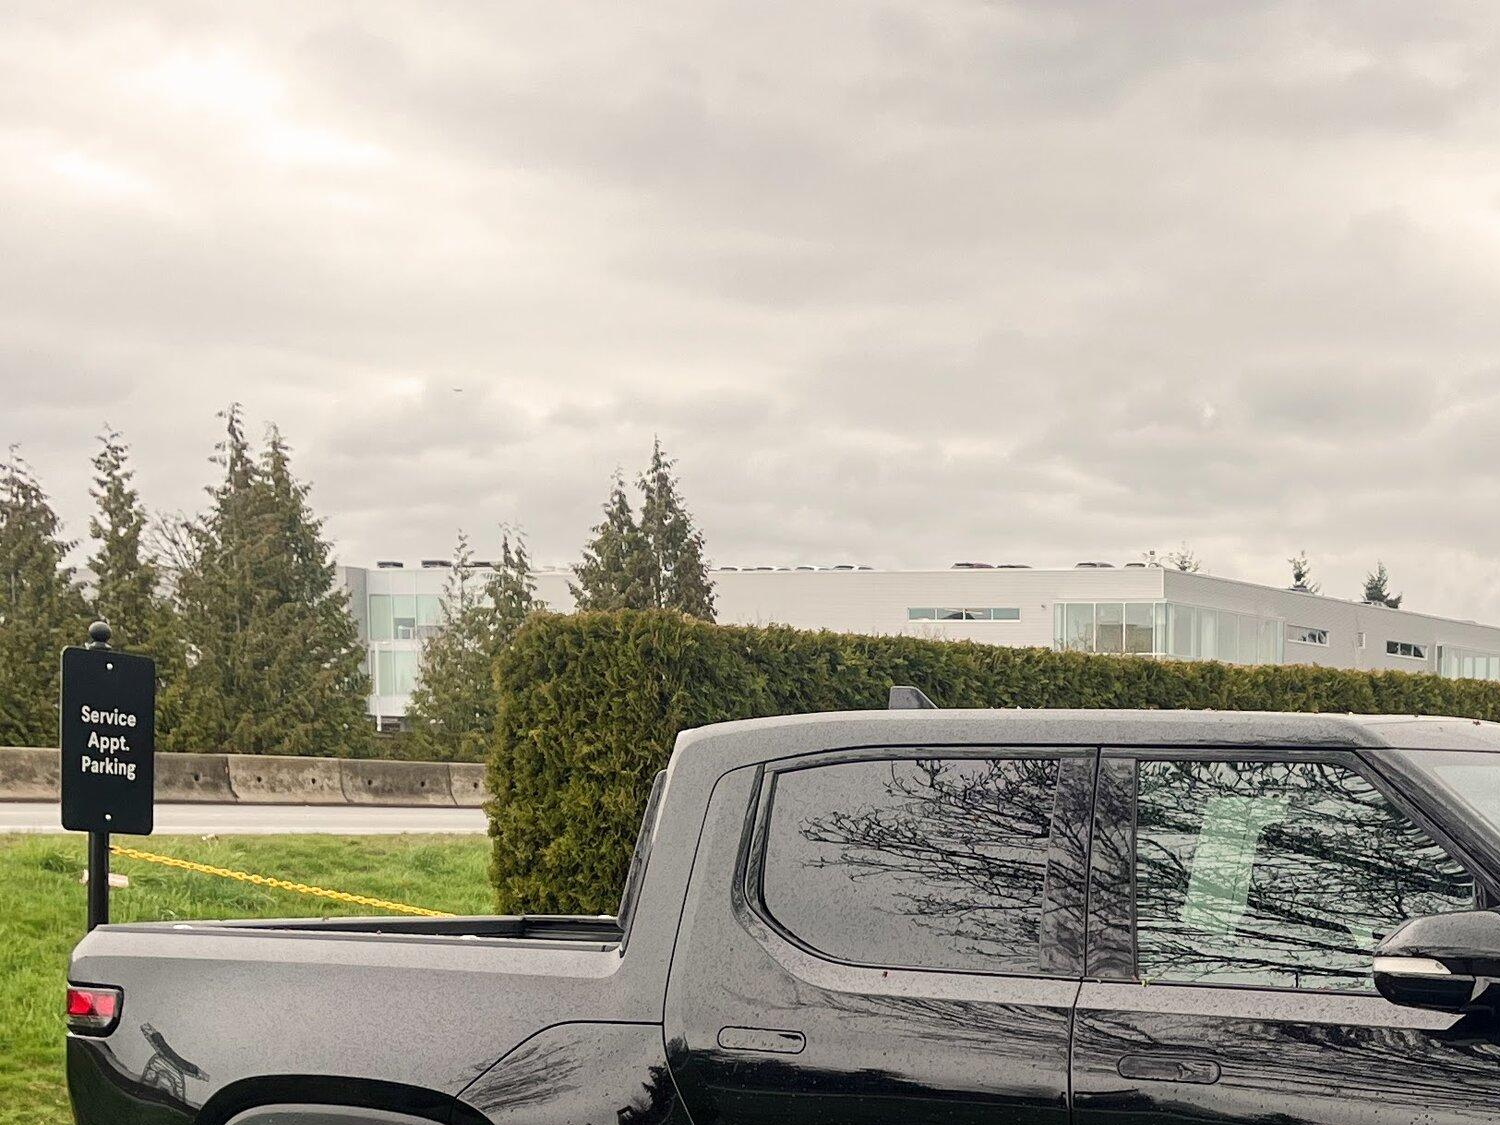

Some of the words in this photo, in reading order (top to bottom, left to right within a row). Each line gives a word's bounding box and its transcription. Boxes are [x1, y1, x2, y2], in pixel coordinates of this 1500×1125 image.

[81, 705, 137, 727] Service
[87, 731, 131, 754] Appt.
[81, 755, 137, 781] Parking
